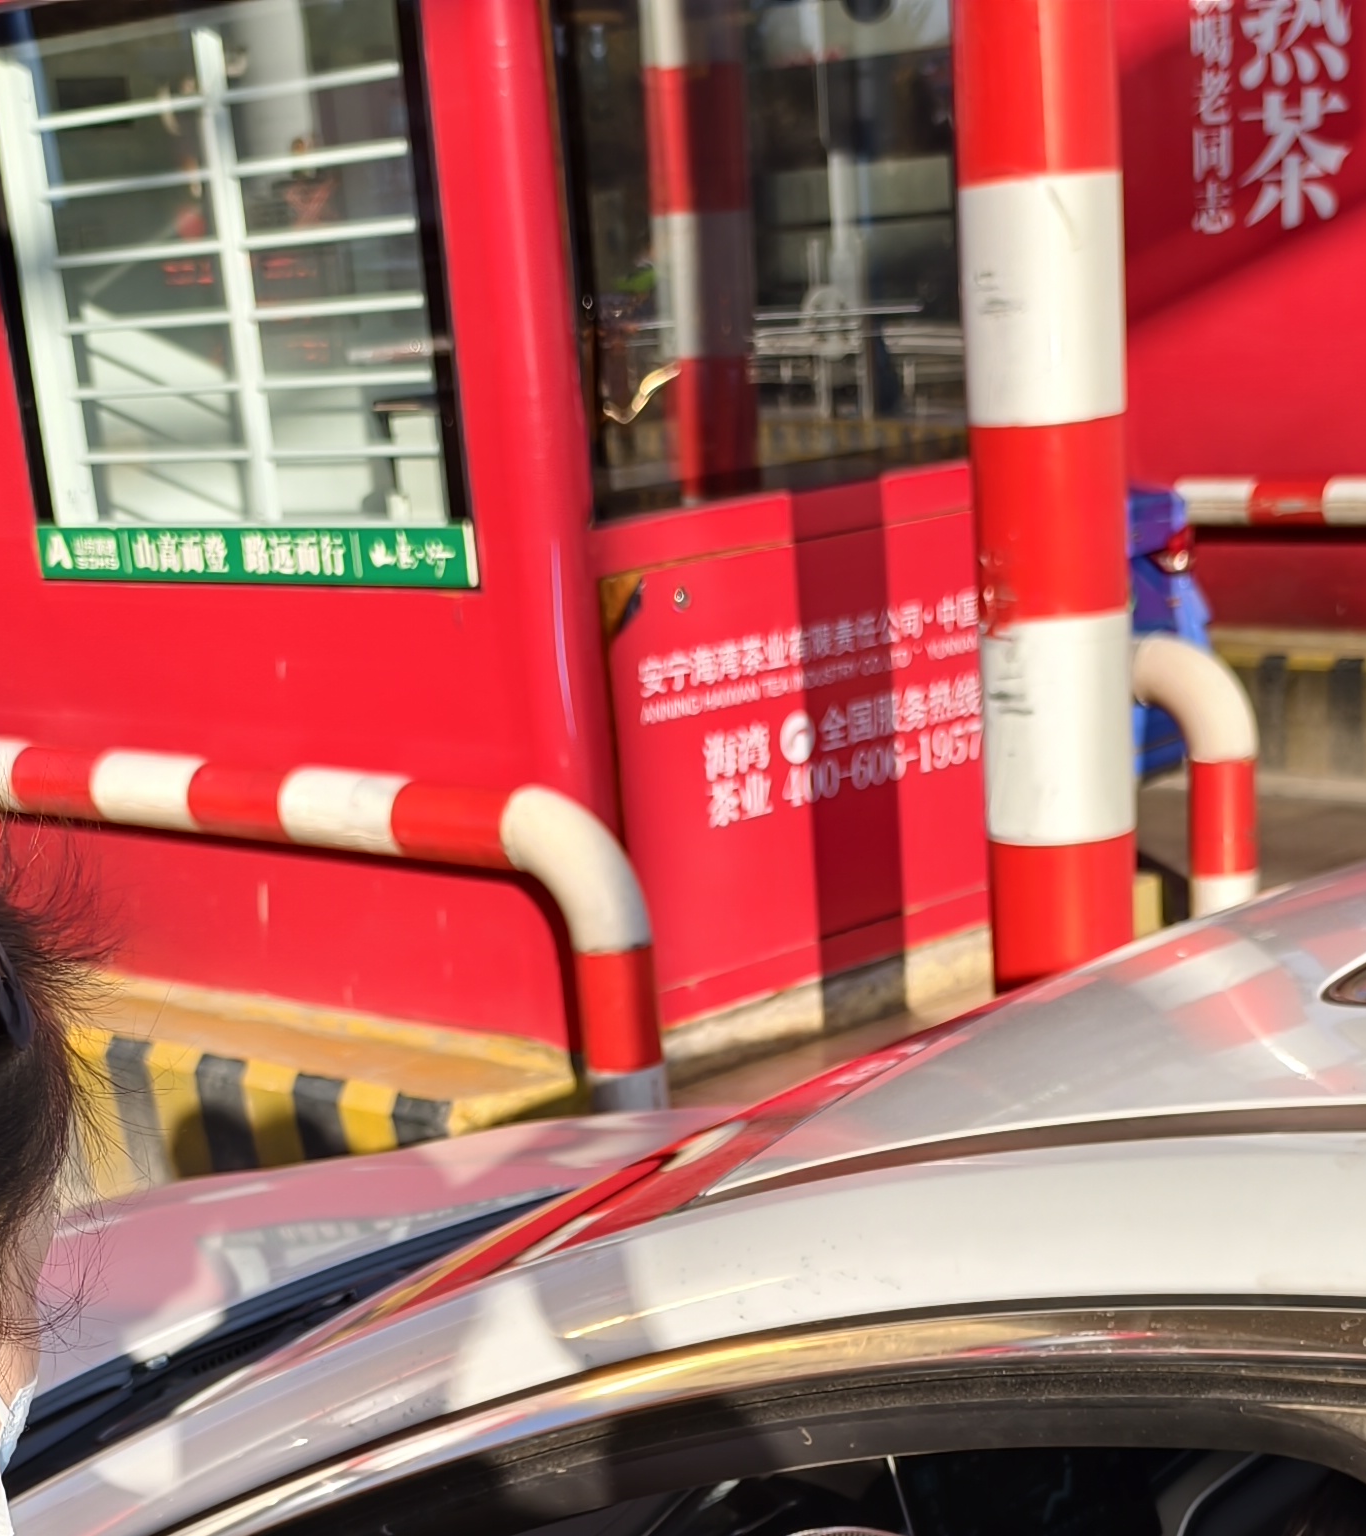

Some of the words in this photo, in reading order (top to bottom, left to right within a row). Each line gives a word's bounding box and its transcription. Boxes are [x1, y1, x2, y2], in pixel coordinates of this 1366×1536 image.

[819, 670, 982, 752] 全国服务热线
[708, 769, 773, 828] 茶业
